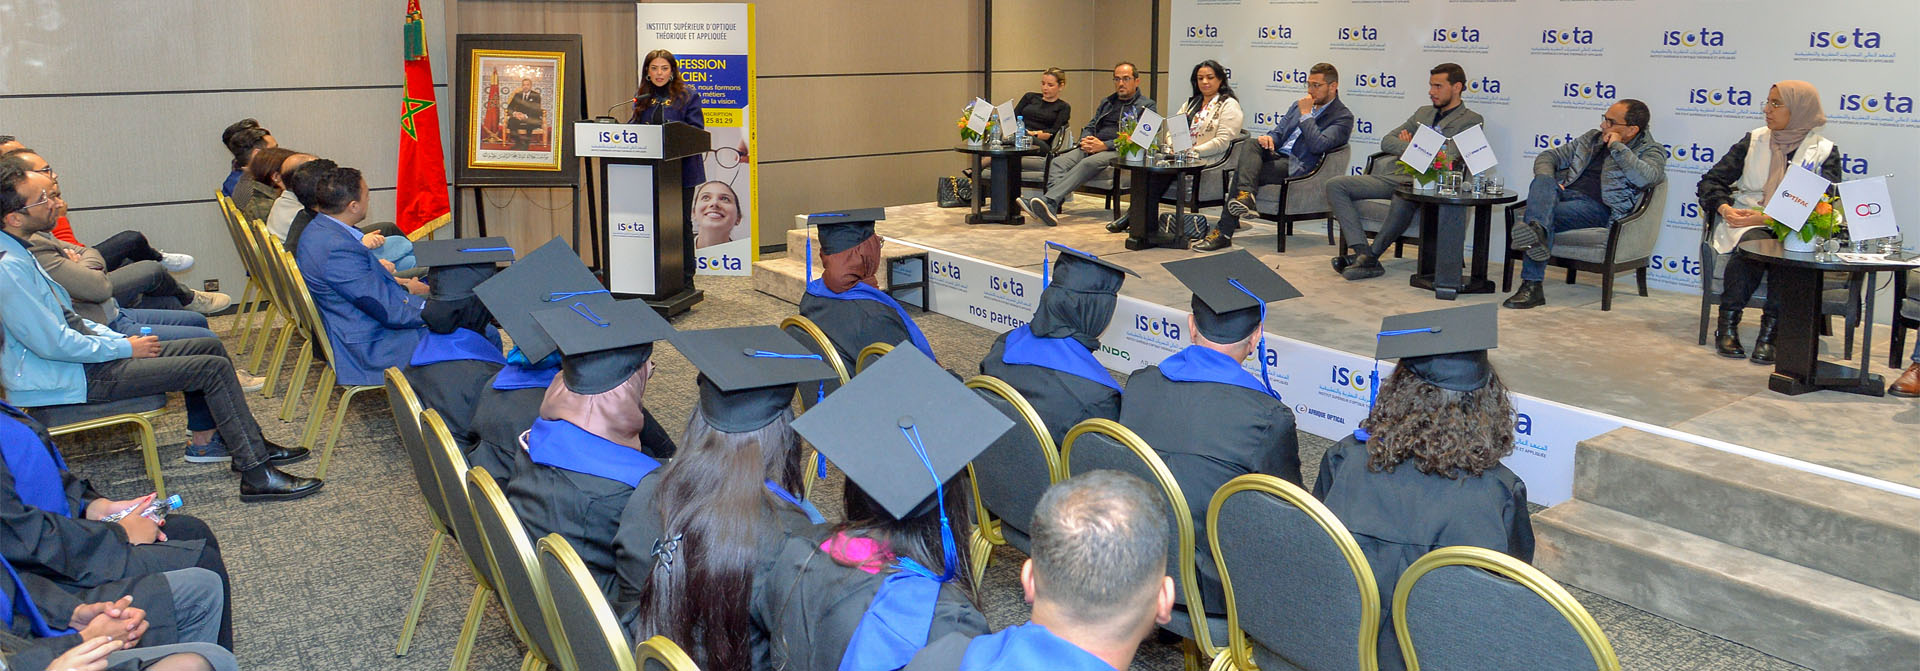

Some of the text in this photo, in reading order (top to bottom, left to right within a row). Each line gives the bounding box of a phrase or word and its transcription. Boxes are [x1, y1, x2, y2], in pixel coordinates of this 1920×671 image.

[646, 22, 737, 31] INSTITUT SUPÉRIEUR D'OPTIQUE
[1187, 24, 1218, 39] isota
[1258, 24, 1292, 40] isota
[1338, 25, 1378, 42] isota
[1433, 26, 1480, 43] isota
[656, 32, 687, 40] THÉORIQUE
[696, 32, 727, 40] APPLIQUÉE
[1542, 26, 1593, 45] isota
[1663, 27, 1724, 47] isota
[1809, 28, 1881, 49] isota
[1273, 68, 1307, 84] isota
[1355, 72, 1397, 88] isota
[1564, 81, 1616, 99] isota
[1689, 86, 1752, 106] isota
[1839, 92, 1913, 113] isota
[599, 129, 638, 144] isota
[1662, 142, 1715, 163] sota
[618, 221, 645, 232] isota
[930, 260, 961, 280] isota
[990, 275, 1024, 298] isota
[969, 304, 987, 319] nos
[1135, 314, 1181, 341] isota
[1327, 413, 1345, 424] OPTICAL
